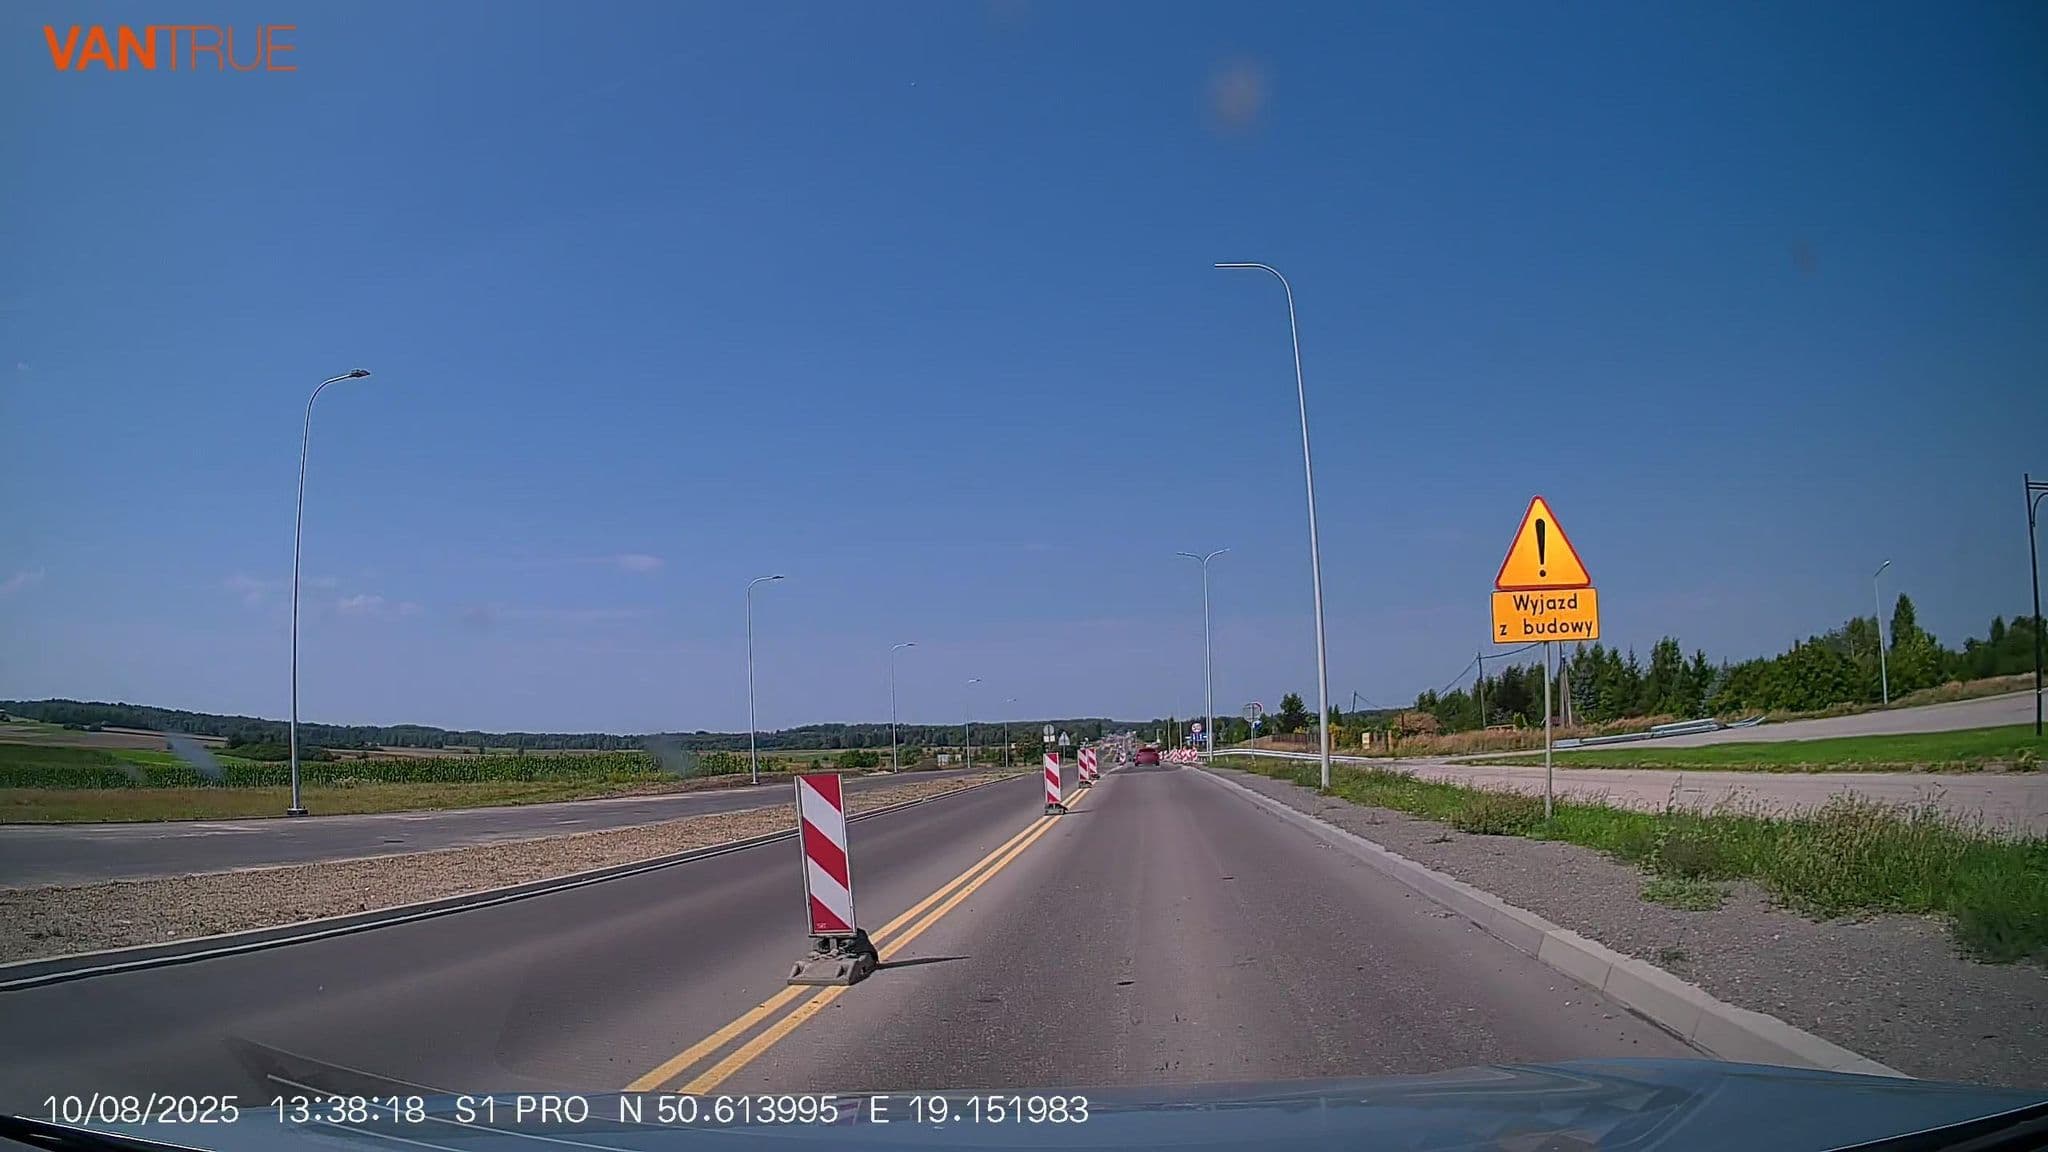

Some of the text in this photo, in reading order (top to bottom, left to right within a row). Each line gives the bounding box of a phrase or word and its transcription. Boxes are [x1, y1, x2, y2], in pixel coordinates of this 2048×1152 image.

[1513, 593, 1578, 616] Wyjazd
[1499, 618, 1593, 638] z budowy
